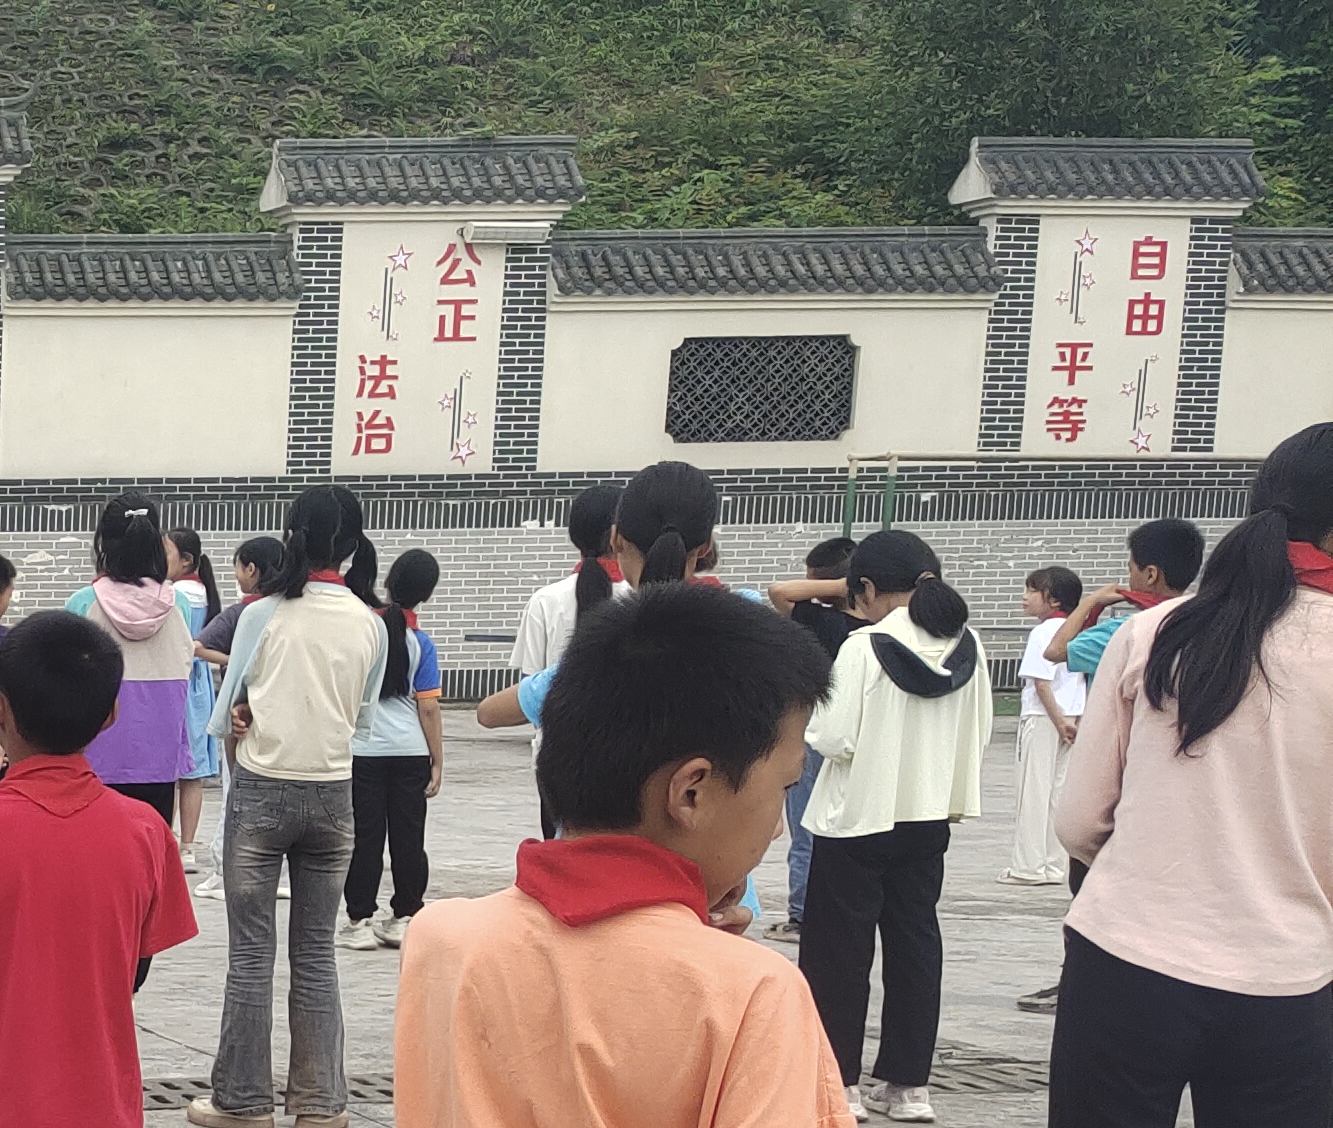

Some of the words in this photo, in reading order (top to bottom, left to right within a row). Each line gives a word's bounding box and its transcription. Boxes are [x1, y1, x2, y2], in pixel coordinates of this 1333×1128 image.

[434, 243, 482, 342] 公正
[1125, 235, 1169, 336] 自由
[351, 354, 399, 456] 法治
[1045, 342, 1093, 443] 平等
